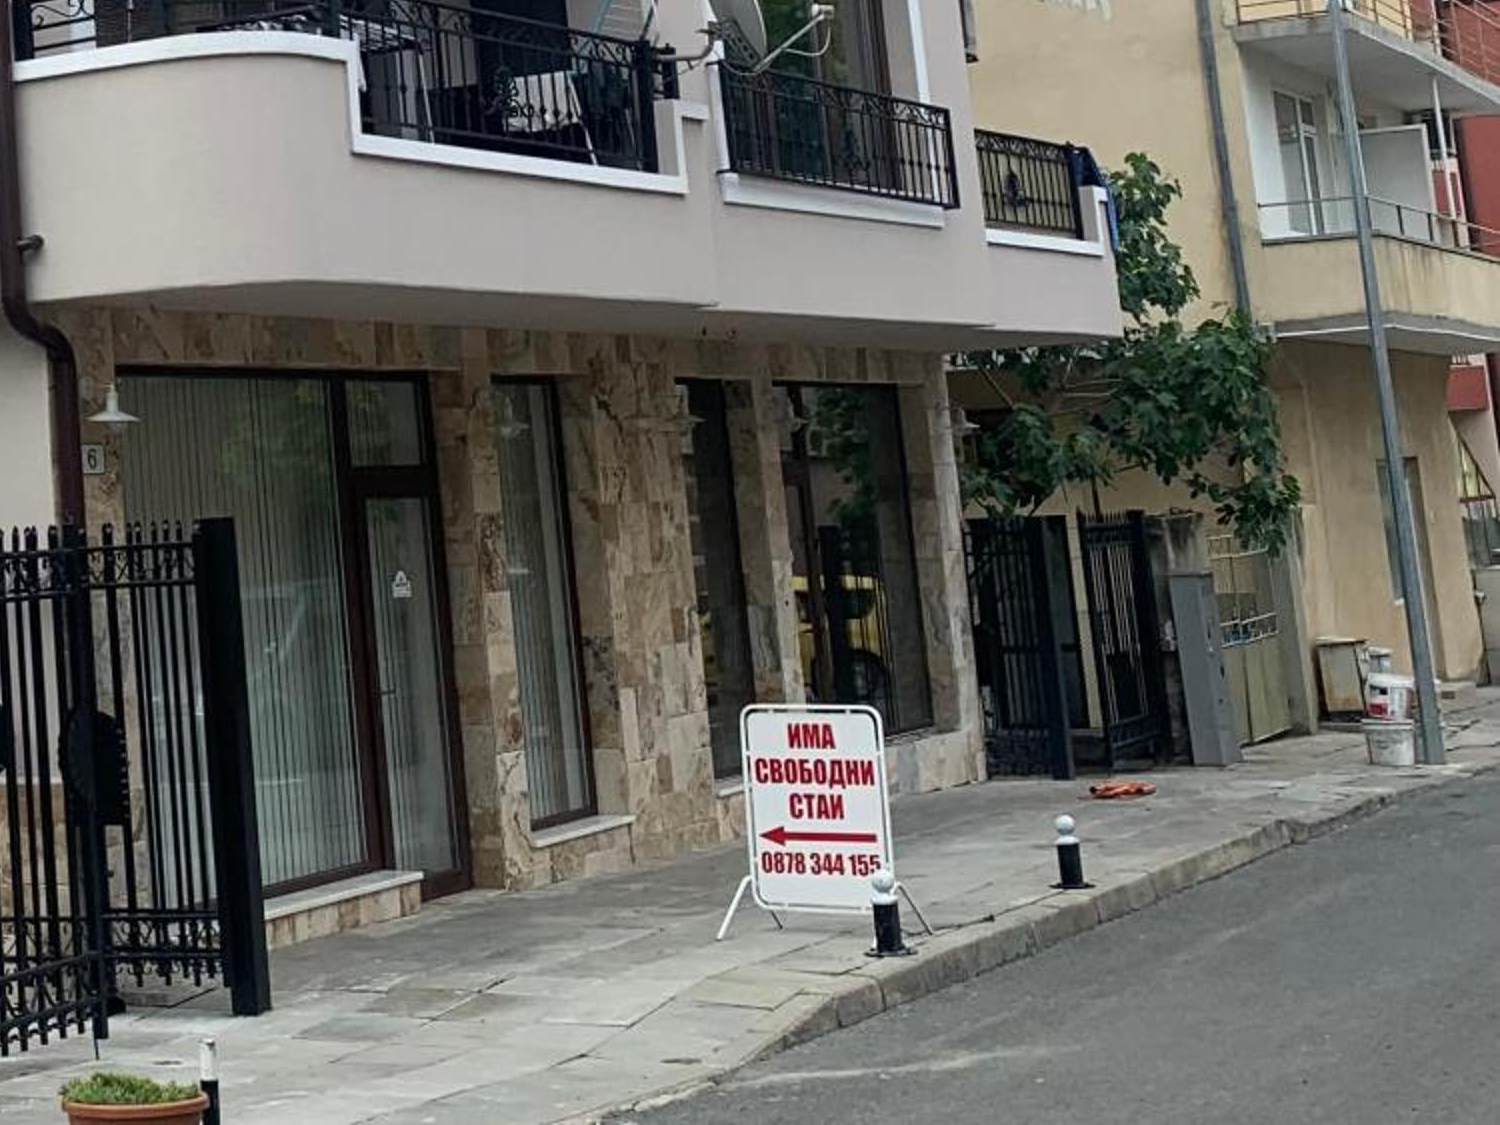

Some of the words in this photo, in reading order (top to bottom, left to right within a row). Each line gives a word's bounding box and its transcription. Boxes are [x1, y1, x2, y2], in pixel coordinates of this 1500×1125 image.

[88, 448, 97, 470] 6
[787, 722, 836, 750] ИМА
[755, 758, 875, 789] СВОБОДНИ
[789, 792, 845, 820] СТАИ
[761, 851, 806, 875] 0878
[810, 853, 845, 876] 344
[849, 854, 881, 876] 155
